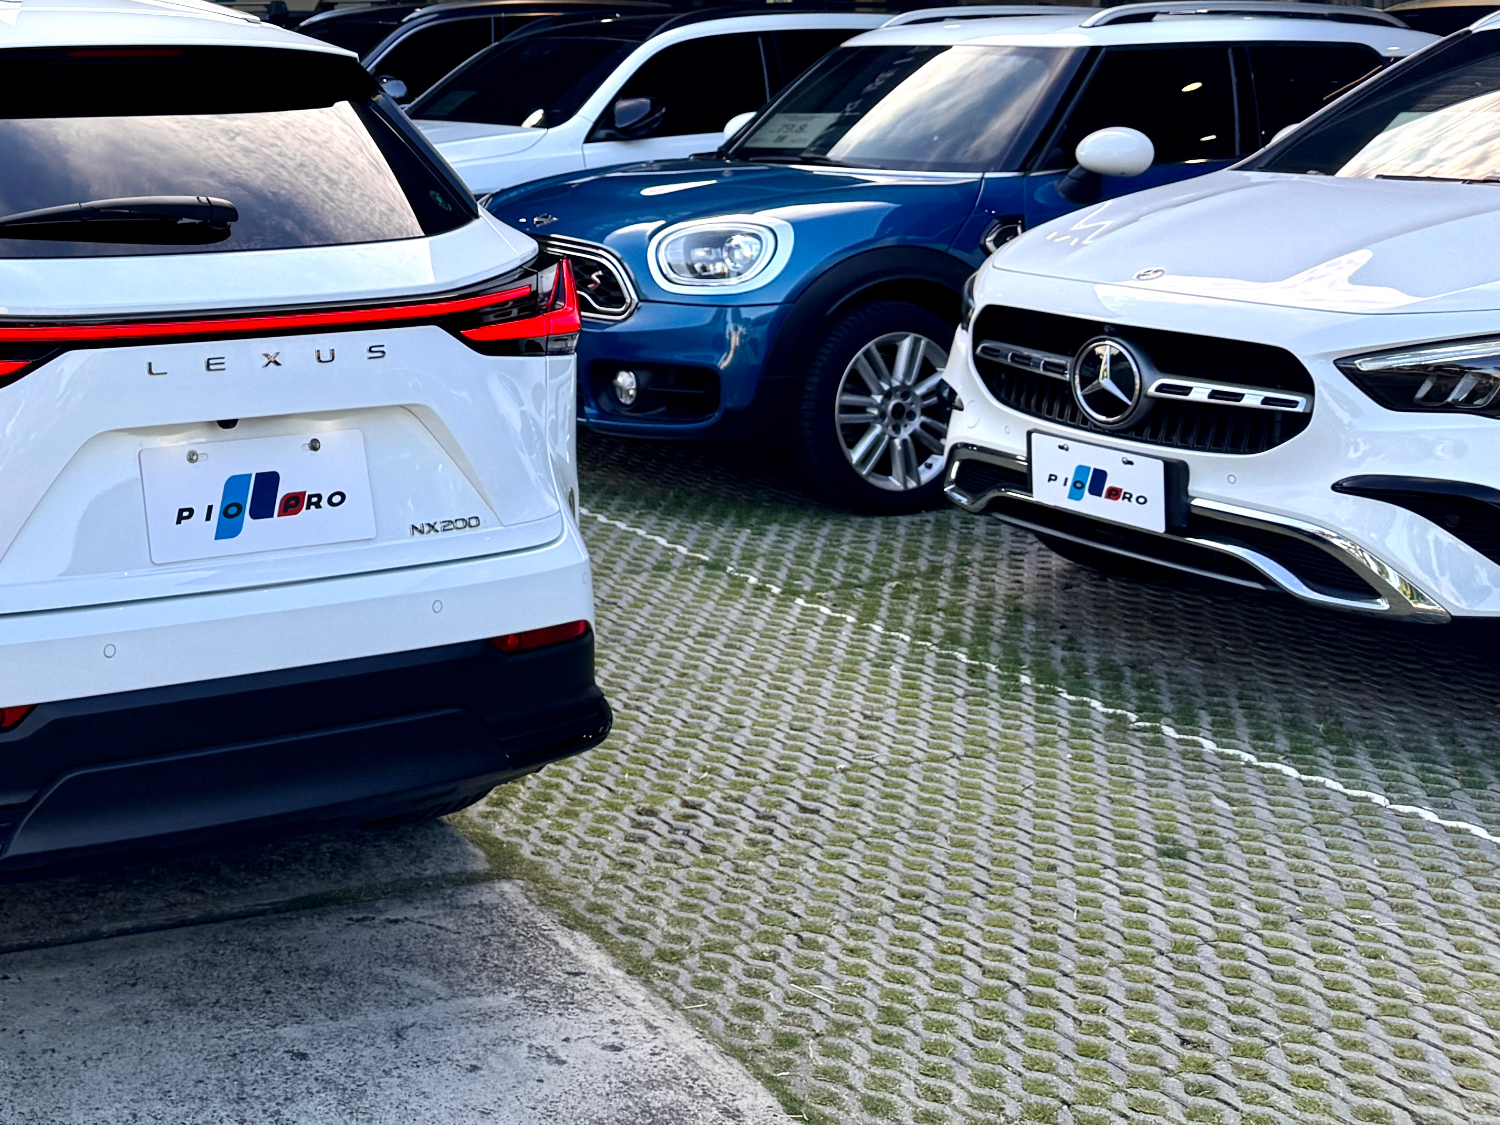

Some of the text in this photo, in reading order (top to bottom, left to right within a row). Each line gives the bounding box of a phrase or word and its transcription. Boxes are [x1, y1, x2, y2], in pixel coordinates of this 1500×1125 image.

[147, 344, 387, 376] LEXUS
[1047, 473, 1148, 505] PIO PRO
[175, 490, 347, 525] PIO PRO
[409, 515, 482, 536] NX200
